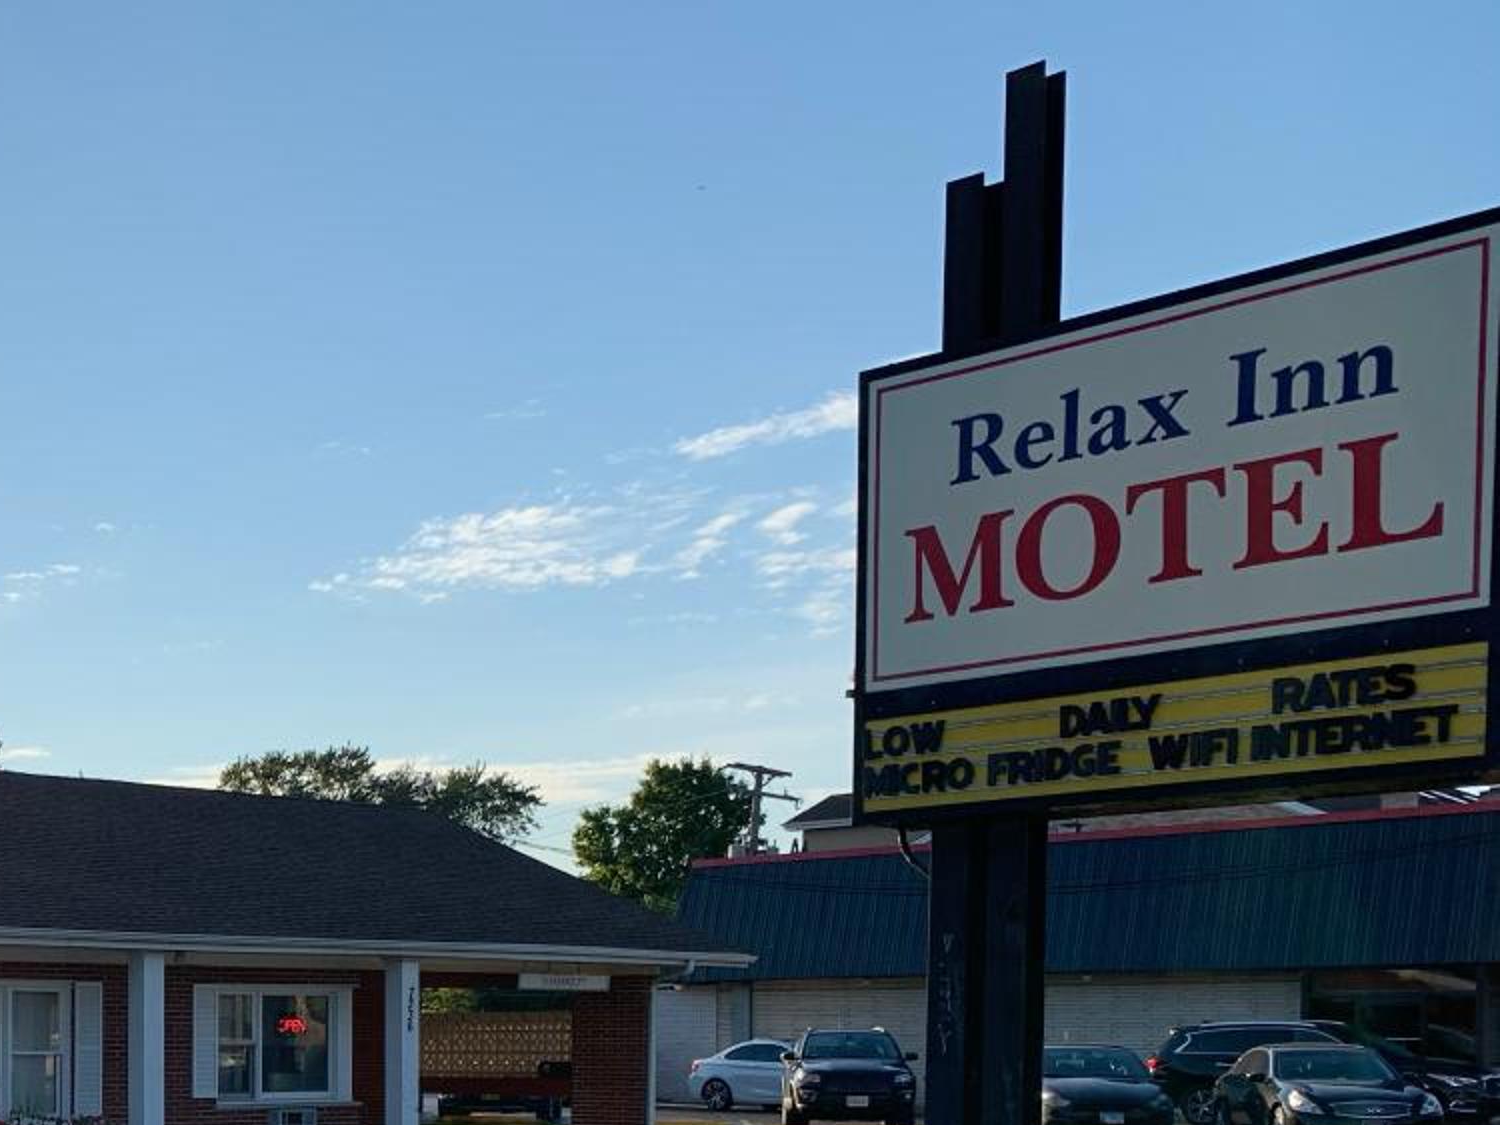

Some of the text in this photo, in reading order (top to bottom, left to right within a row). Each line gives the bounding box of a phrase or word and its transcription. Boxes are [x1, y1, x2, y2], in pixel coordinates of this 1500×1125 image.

[948, 340, 1400, 486] Relax Inn
[903, 432, 1445, 625] MOTEL
[863, 704, 1459, 799] MICRO FRIDGE WIFI INTERNET
[864, 663, 1417, 761] LOW DAILY RATES
